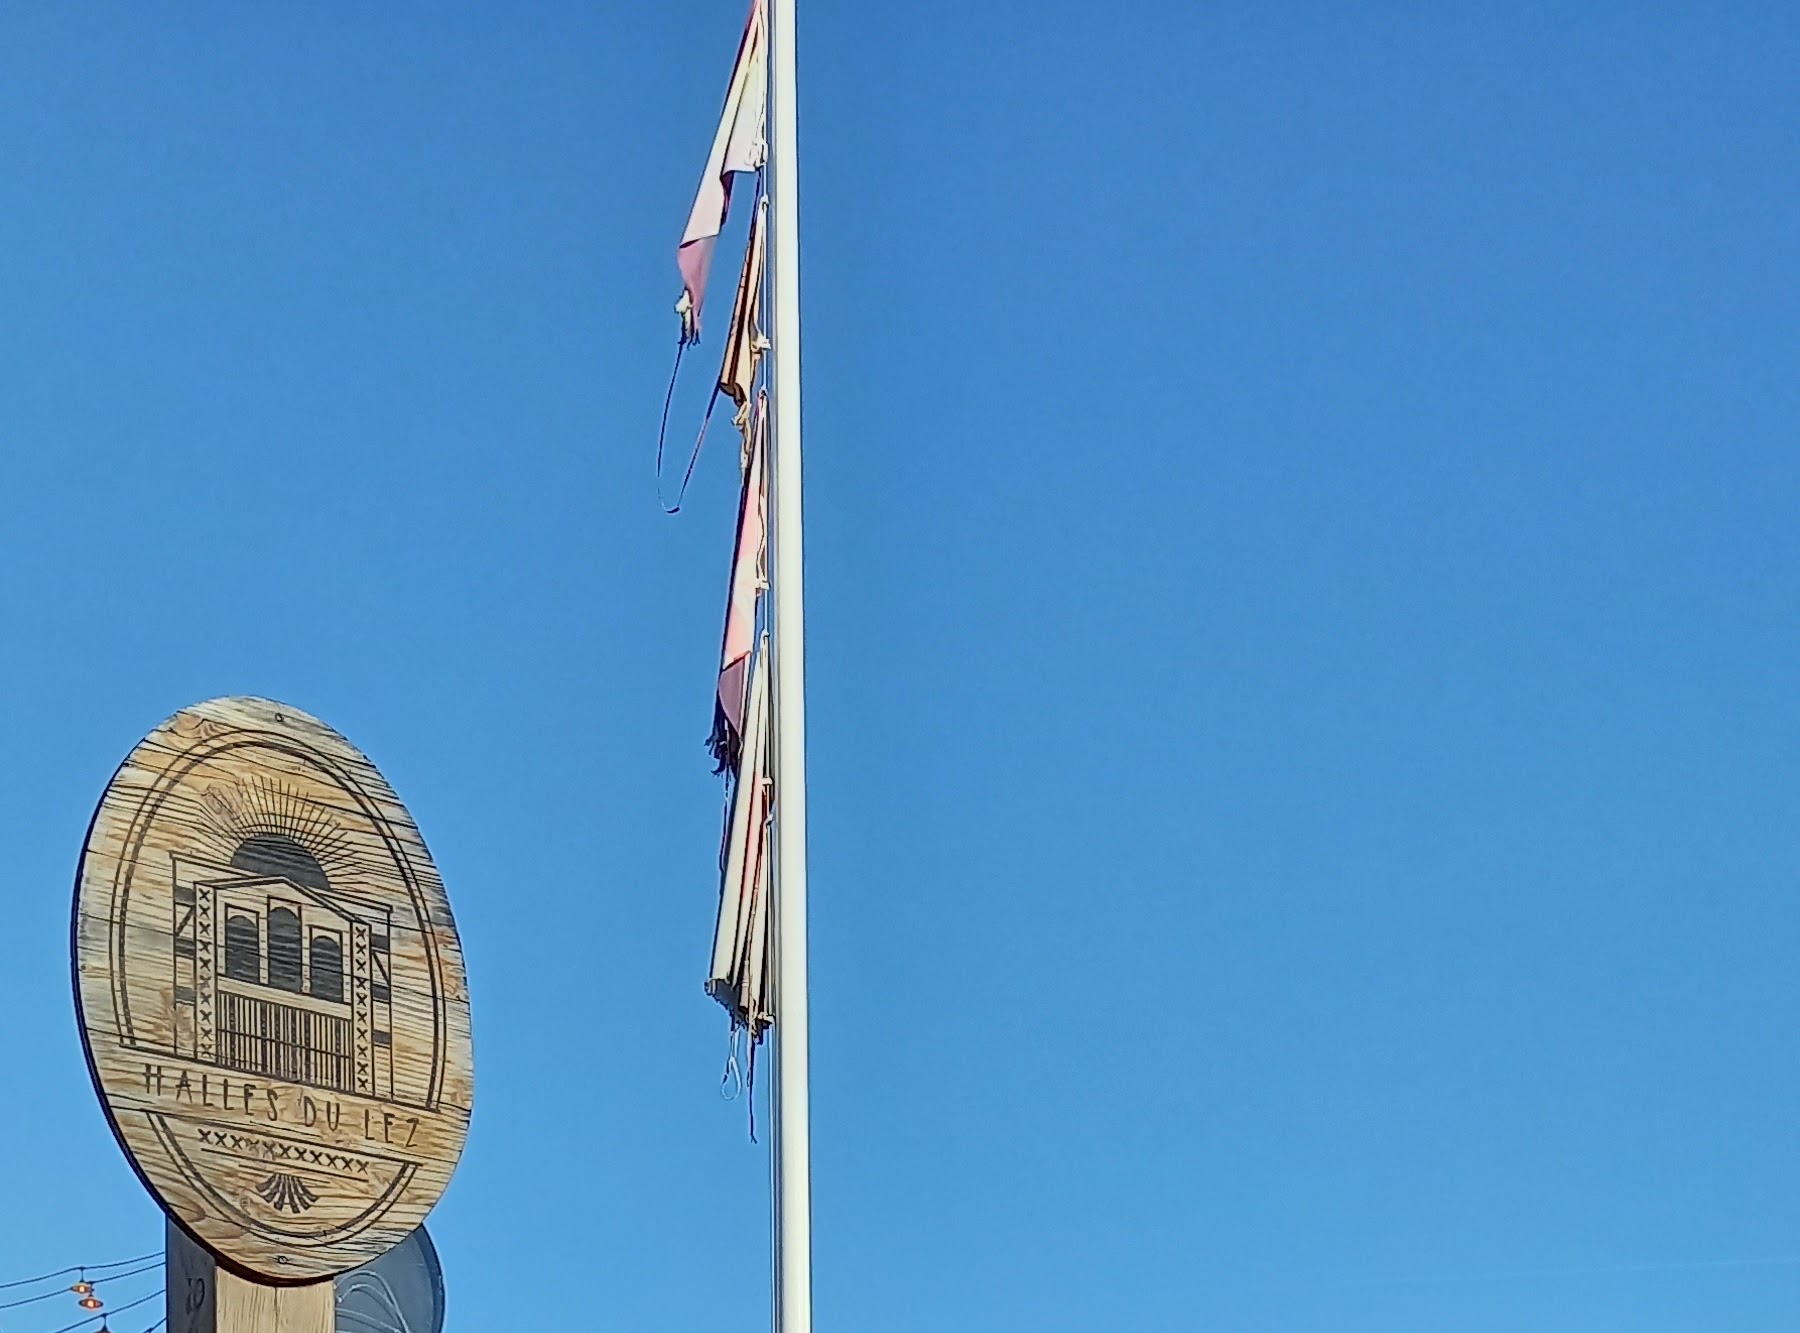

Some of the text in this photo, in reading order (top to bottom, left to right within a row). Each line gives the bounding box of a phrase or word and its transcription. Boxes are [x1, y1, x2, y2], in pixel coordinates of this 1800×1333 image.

[143, 1063, 421, 1148] HALLES DU LEZ
